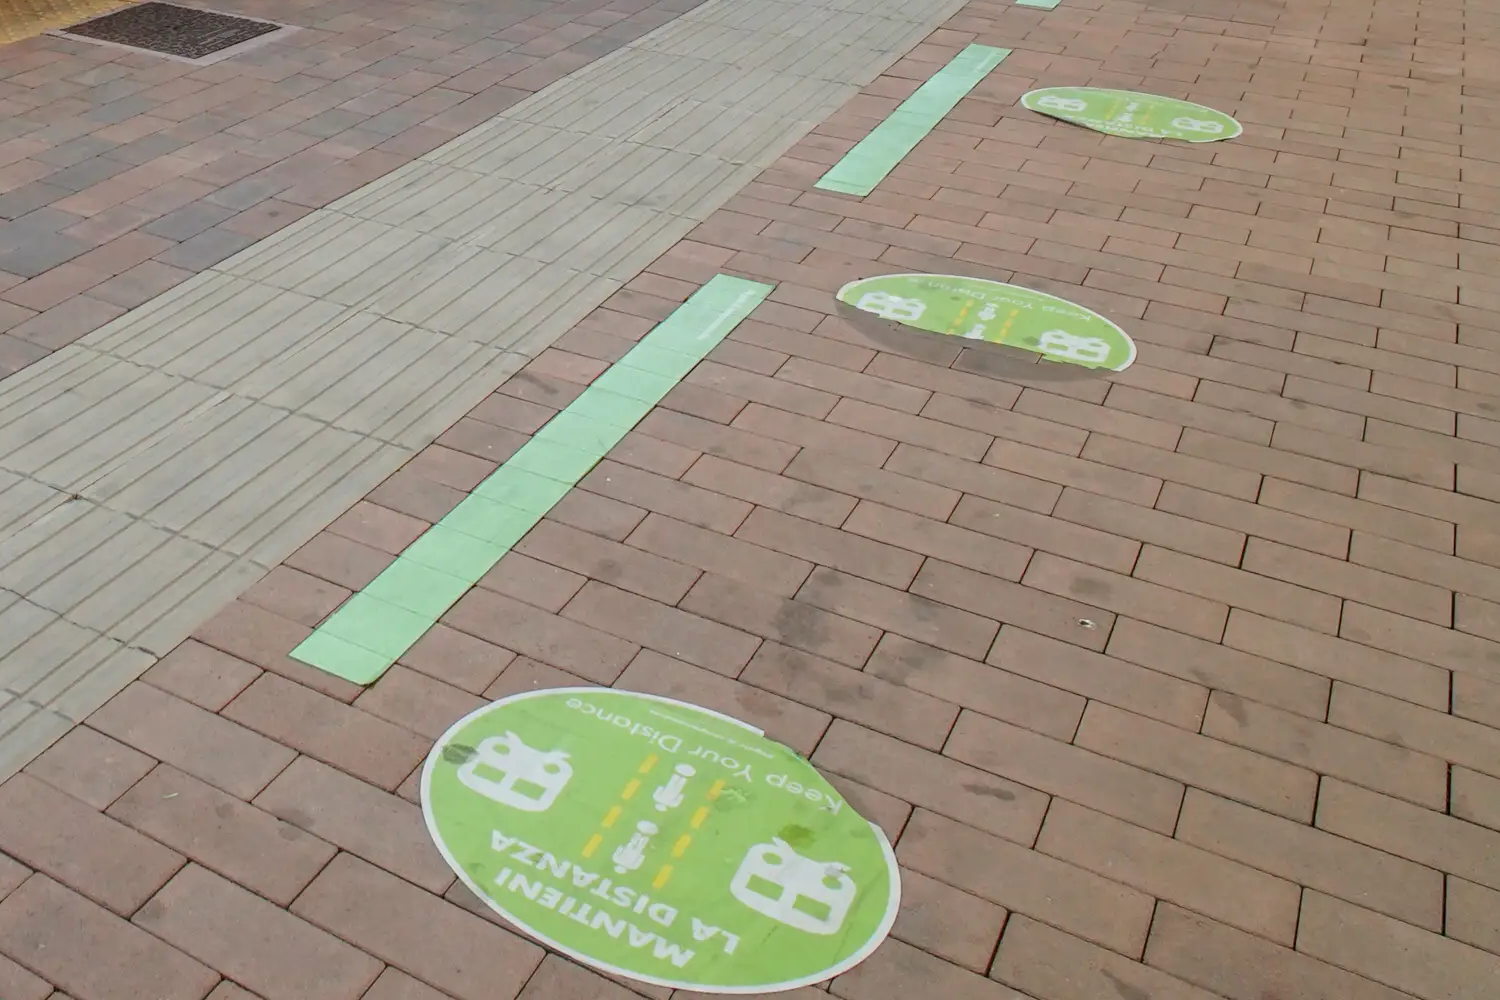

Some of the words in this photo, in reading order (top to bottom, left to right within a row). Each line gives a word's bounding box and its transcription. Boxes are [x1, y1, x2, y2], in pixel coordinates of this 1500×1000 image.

[565, 697, 684, 754] Distance
[688, 744, 753, 783] Your
[765, 772, 844, 816] Keep
[490, 828, 679, 928] DISTANZA
[494, 867, 697, 969] MANTIENI
[690, 916, 741, 956] LA
